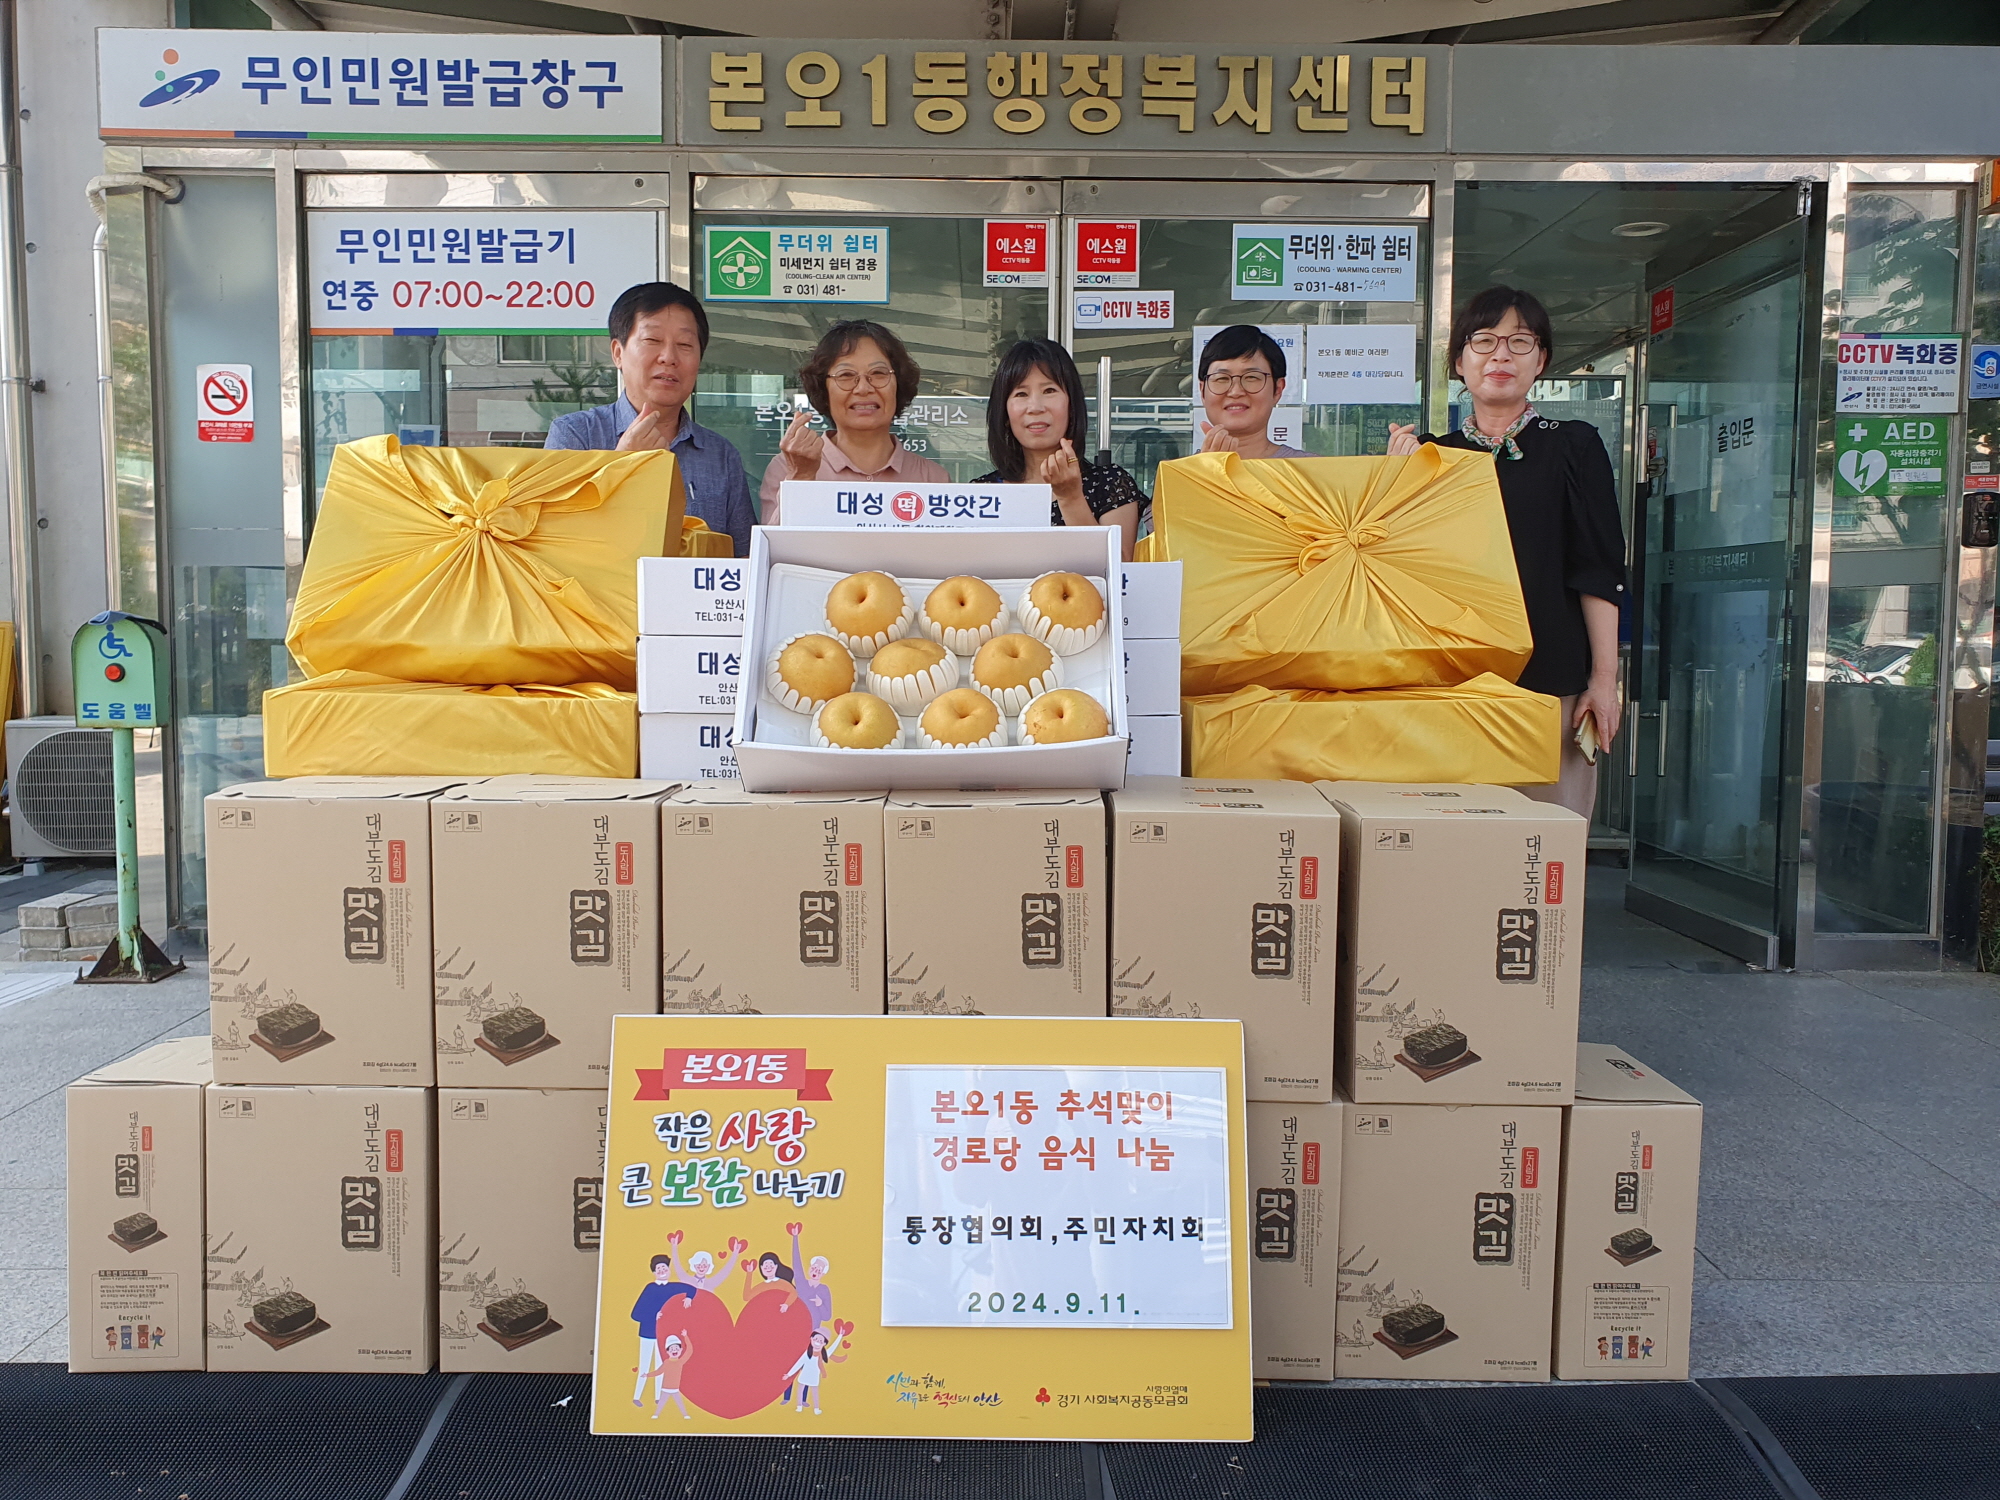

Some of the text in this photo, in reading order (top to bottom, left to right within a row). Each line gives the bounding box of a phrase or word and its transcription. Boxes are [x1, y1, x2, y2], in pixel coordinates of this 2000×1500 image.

[241, 56, 624, 110] 무인민원발급창구
[708, 50, 1427, 135] 본오1동행정복지센터
[335, 228, 577, 265] 무인민원발급기
[777, 233, 879, 255] 무더위 쉼터
[996, 238, 1036, 254] 에스원
[1086, 238, 1126, 254] 에스원
[1382, 235, 1411, 261] 쉼터
[779, 257, 878, 272] 미세먼지 쉼터 겸용
[835, 272, 847, 281] AIR
[847, 272, 872, 282] CENTER)
[987, 275, 1020, 284] SECOM
[1077, 275, 1111, 284] SECOM
[1297, 266, 1402, 275] (COOLING WARMING CENTER)
[322, 278, 595, 311] 연중 07:00~22:00
[797, 284, 846, 297] 031) 481-
[1103, 300, 1170, 319] CCTV 녹화중
[1654, 300, 1670, 319] 에스원
[902, 439, 928, 451] 653
[1717, 416, 1755, 453] 출입문
[1884, 422, 1935, 440] AED
[1900, 458, 1931, 466] 설치시설
[836, 491, 1002, 519] 대성 떡 방앗간
[694, 567, 741, 591] 대성
[714, 599, 745, 610] 안산시
[82, 702, 152, 720] 도움벨
[365, 812, 383, 884] 대부도김
[592, 815, 611, 886] 대부도김
[822, 817, 840, 888] 대부도김
[1043, 819, 1061, 889] 대부도김
[1277, 829, 1295, 899] 대부도김
[1523, 834, 1542, 904] 대부도김
[347, 892, 380, 957] 맛김
[573, 893, 607, 958] 맛김
[803, 896, 836, 958] 맛김
[1024, 898, 1057, 961] 맛김
[1254, 908, 1289, 970] 맛김
[1500, 913, 1535, 975] 맛김
[681, 1052, 788, 1084] 본오1동
[930, 1090, 1173, 1122] 본오1동 추석맞이
[128, 1111, 139, 1152] 대부도김
[364, 1103, 381, 1173] 대부도김
[655, 1109, 813, 1164] 작은 사랑
[933, 1137, 1175, 1171] 경로당 음식 나눔
[1280, 1117, 1298, 1185] 대부도김
[1499, 1121, 1518, 1189] 대부도김
[1630, 1130, 1641, 1170] 대부도김
[117, 1157, 138, 1195] 맛김
[621, 1159, 845, 1207] 큰 보람 나누기
[1616, 1175, 1637, 1210] 맛김
[344, 1180, 377, 1244] 맛김
[1260, 1193, 1293, 1254] 맛김
[1478, 1197, 1511, 1259] 맛김
[901, 1214, 1204, 1245] 통장협의회,주민자치회
[967, 1291, 1141, 1317] 2024.9.11.
[972, 1393, 1004, 1407] 안산
[1057, 1394, 1189, 1408] 경기 사회복지공동모금회
[1146, 1385, 1188, 1394] 사랑의열매
